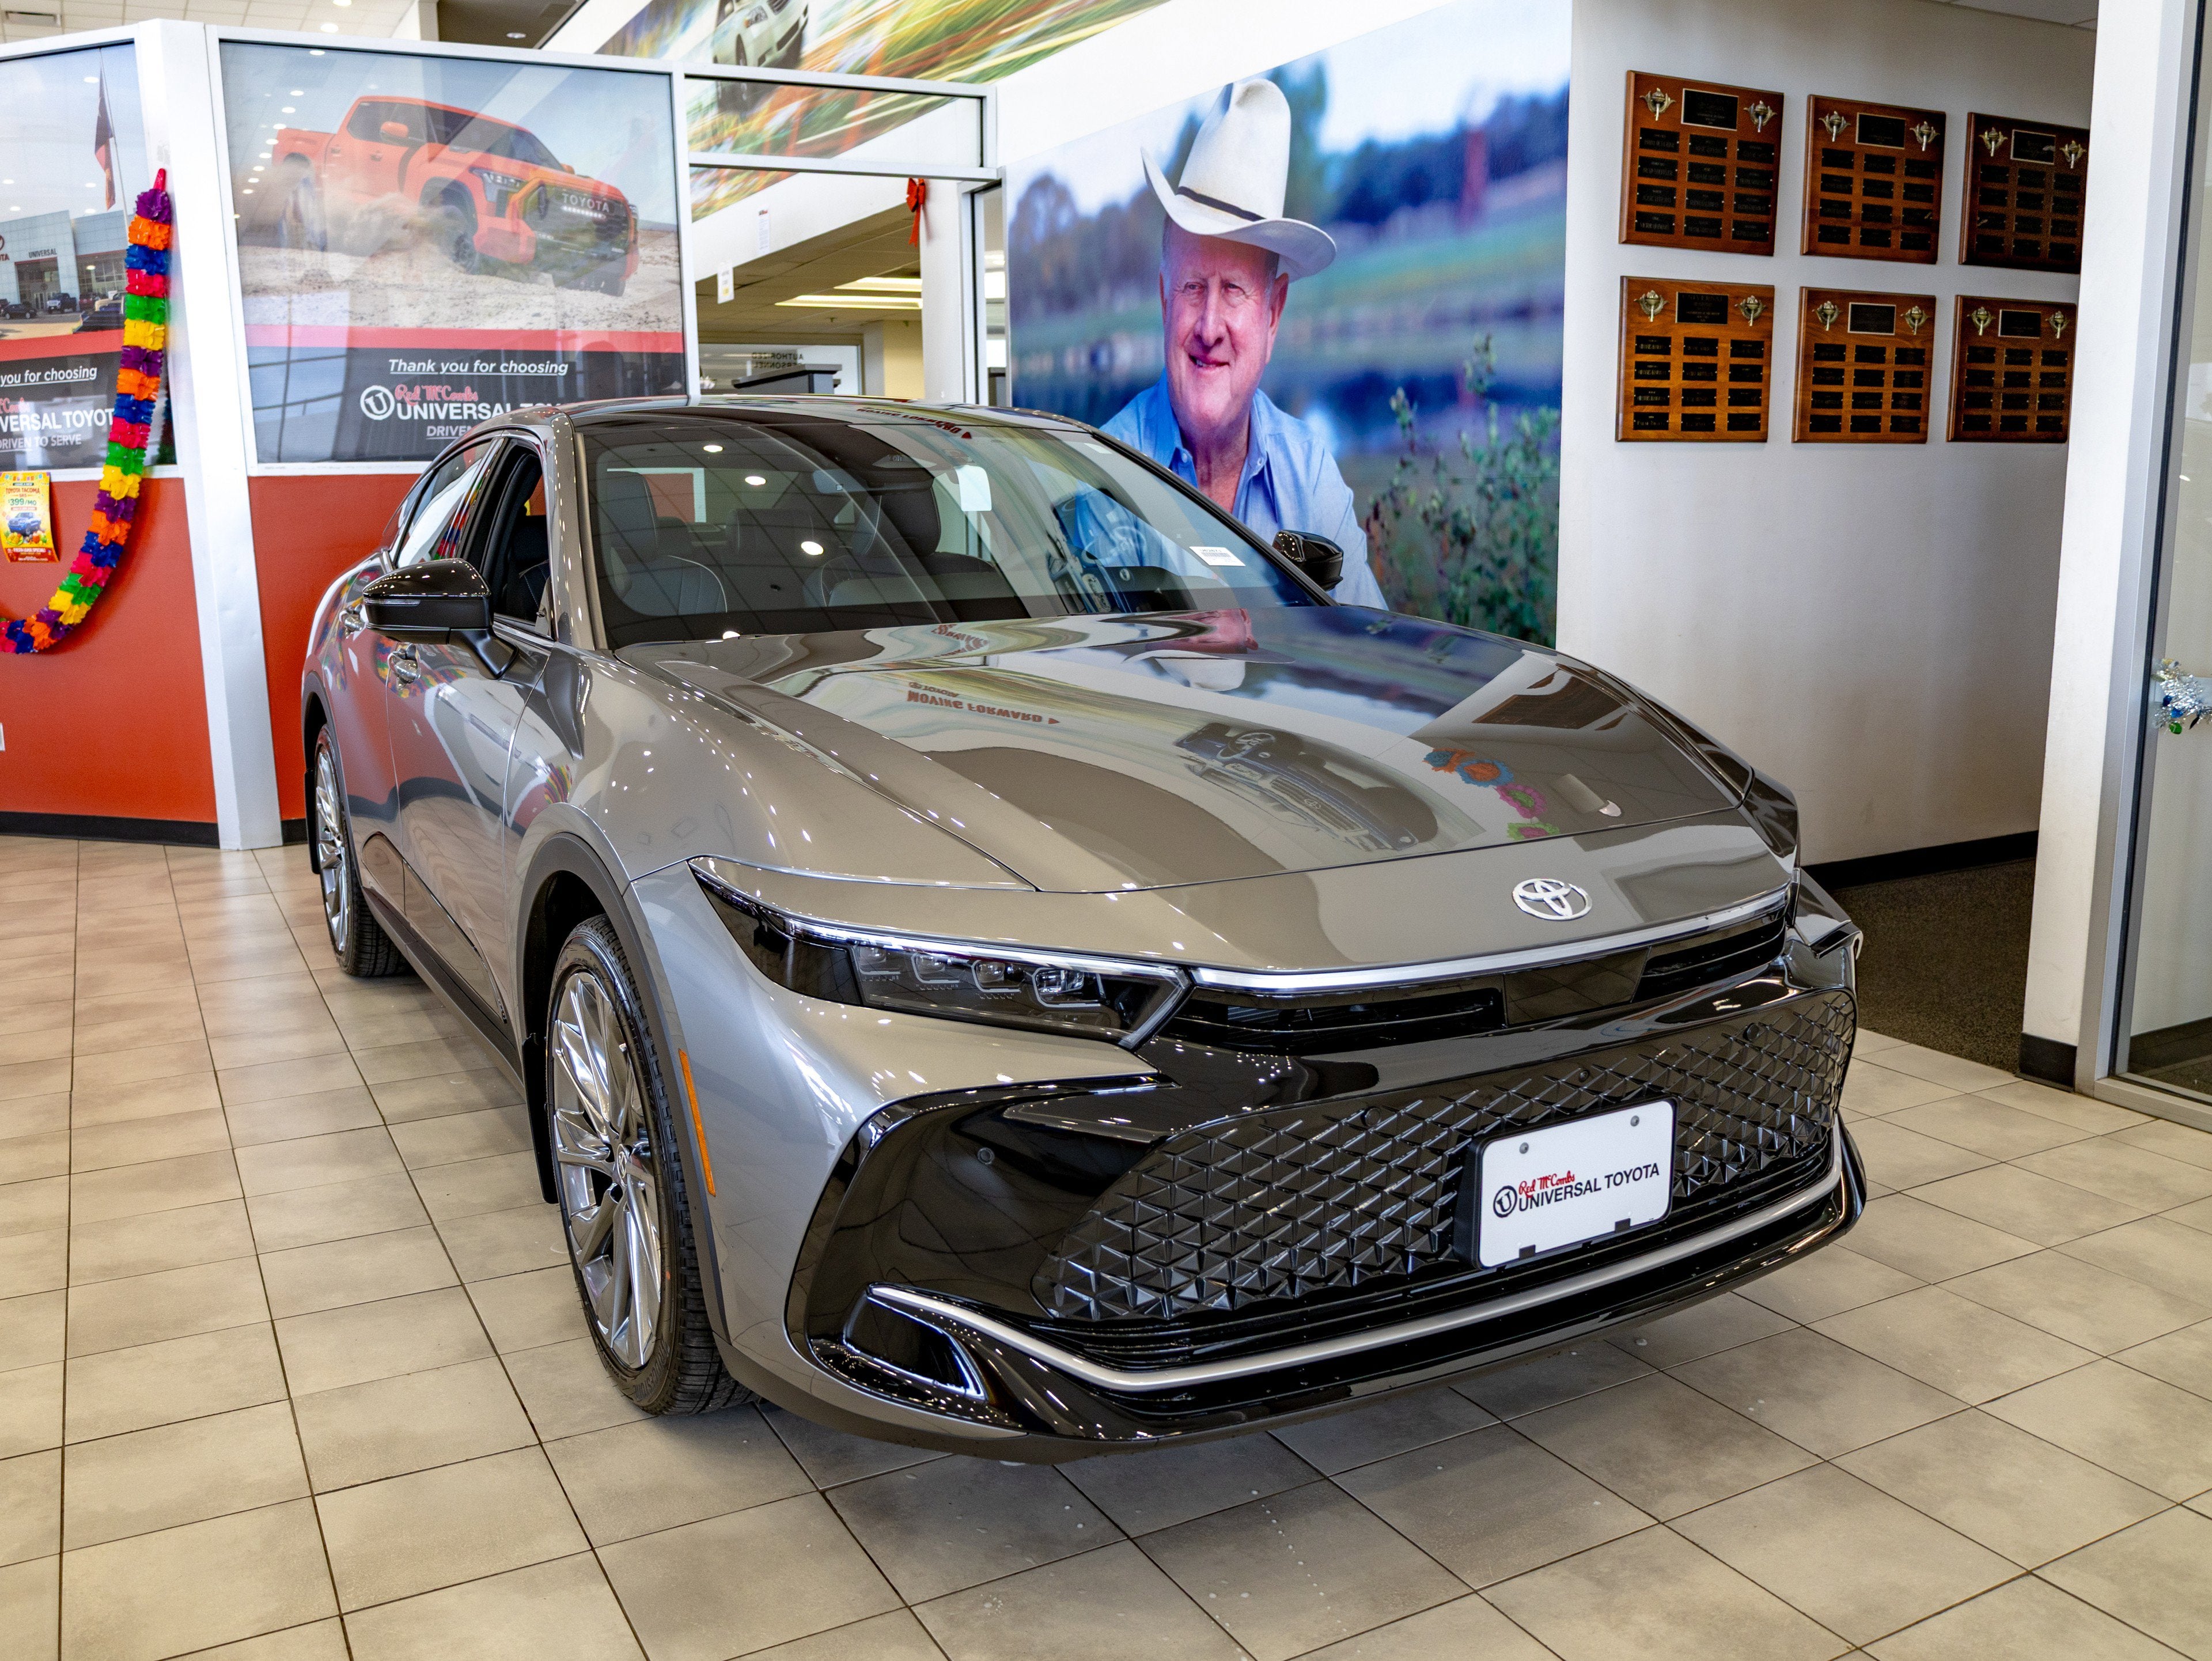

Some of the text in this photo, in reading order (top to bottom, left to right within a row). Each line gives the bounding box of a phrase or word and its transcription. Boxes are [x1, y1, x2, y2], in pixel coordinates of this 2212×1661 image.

[561, 193, 609, 212] TOYOTA
[28, 248, 57, 258] UNIVERSAL
[24, 370, 41, 383] for
[44, 365, 97, 380] choosing
[389, 359, 568, 376] Thank you for choosing
[395, 384, 478, 406] Red McCombs
[0, 408, 115, 432] VERSAL TOYOT
[51, 434, 82, 446] SERVE
[1518, 1170, 1575, 1198] Red McCombs
[1519, 1163, 1660, 1212] UNIVERSAL TOYOTA
